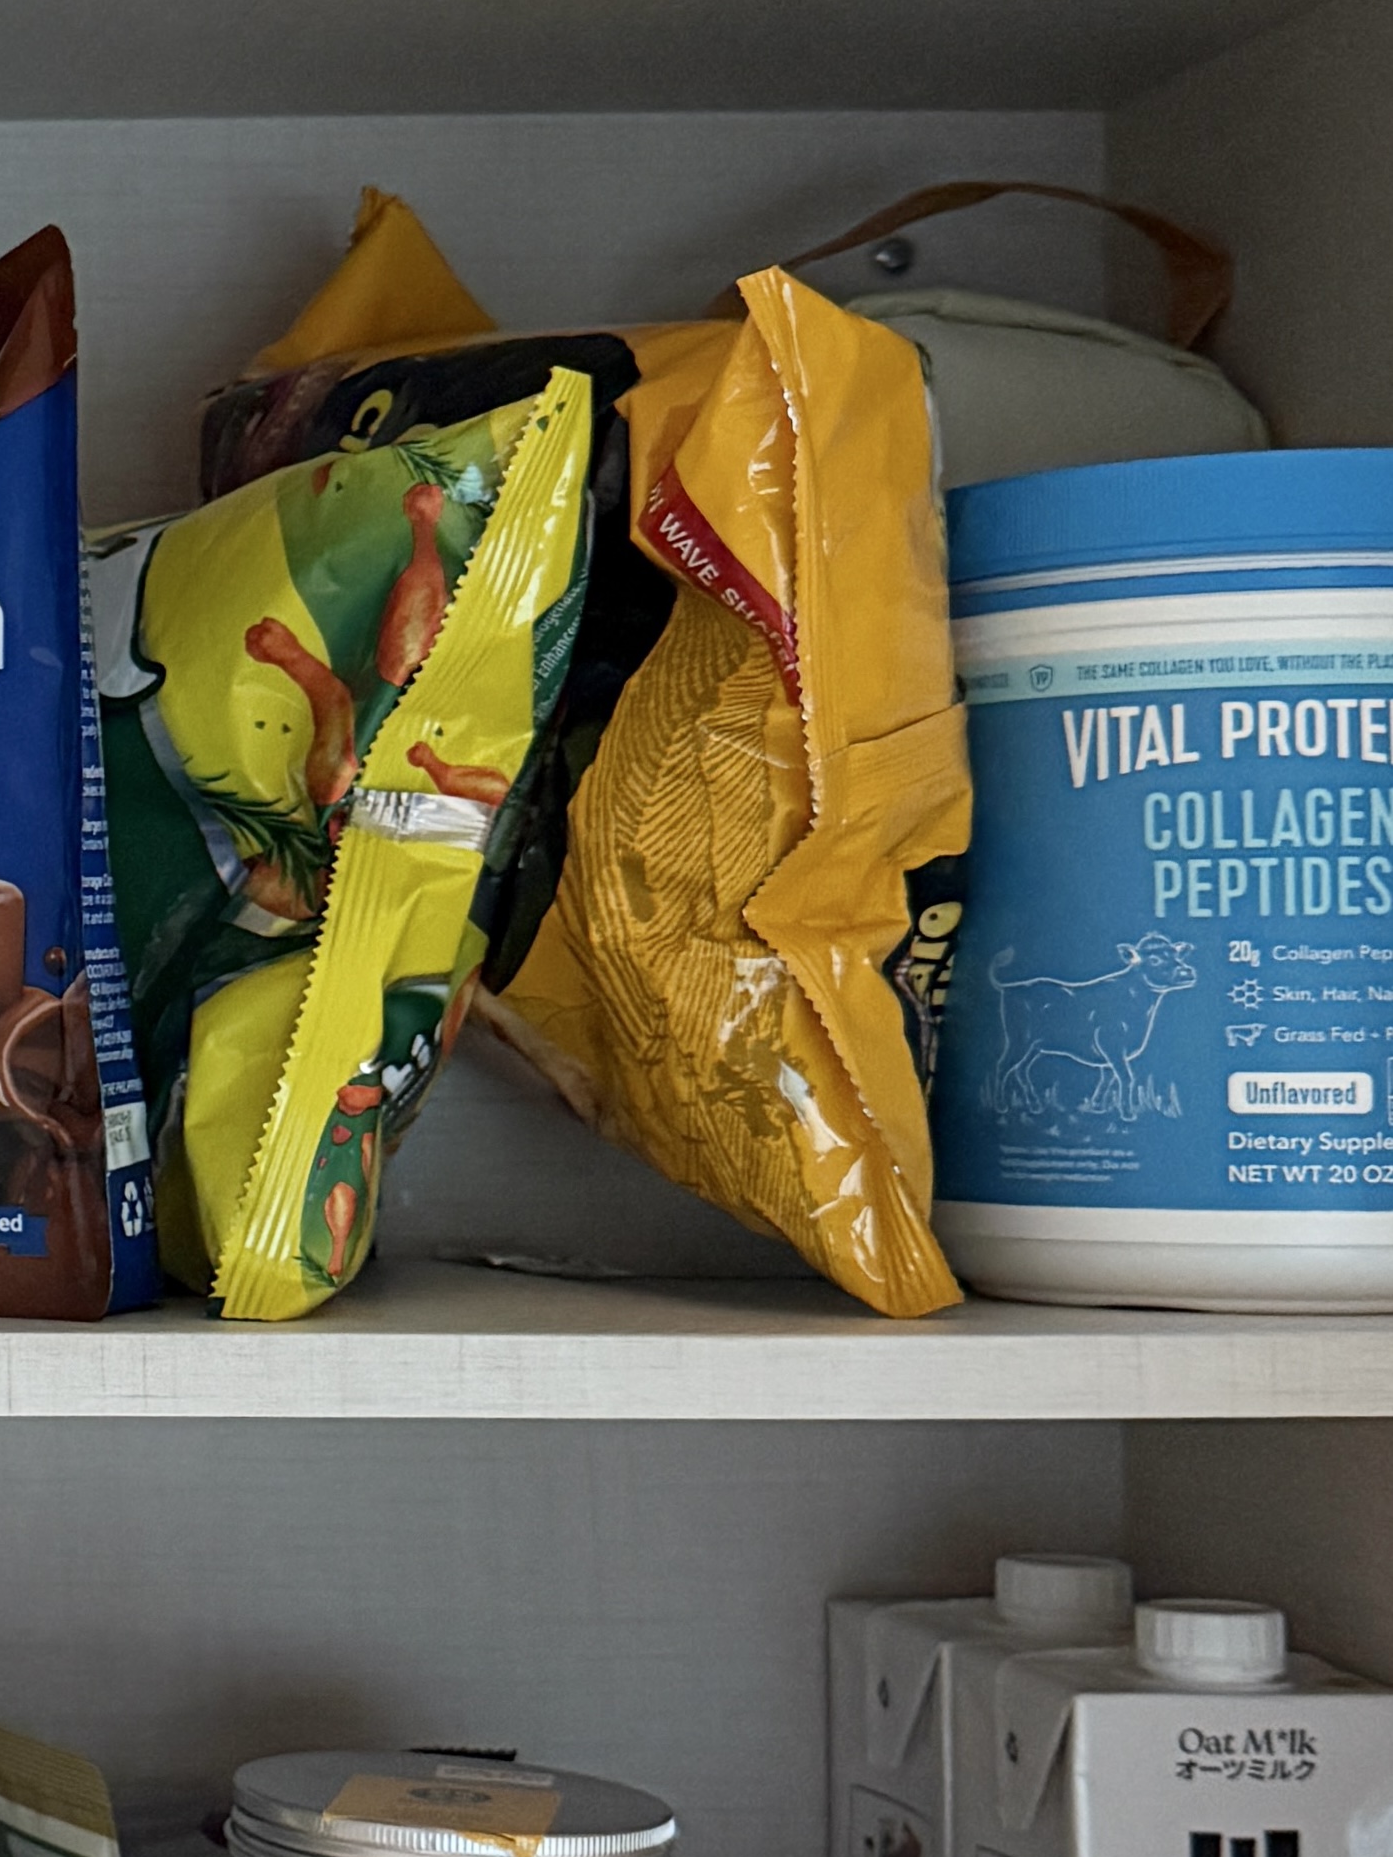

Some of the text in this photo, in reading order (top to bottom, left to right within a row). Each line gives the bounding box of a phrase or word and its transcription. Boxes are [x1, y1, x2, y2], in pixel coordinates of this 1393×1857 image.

[658, 511, 721, 588] WAVE
[1077, 664, 1100, 681] THE
[1100, 662, 1135, 680] SAME
[1138, 658, 1204, 678] COLLAGEN
[1208, 657, 1236, 674] YOU
[1277, 654, 1336, 671] WITHOUT
[1341, 653, 1364, 670] THE
[1367, 652, 1393, 670] PLA
[1062, 703, 1201, 789] VITAL
[1153, 855, 1393, 918] PEPTIDES
[1229, 939, 1393, 968] 20g Collagen Pep
[1273, 986, 1362, 1004] Skin, Hair,
[1273, 1026, 1364, 1043] Grass Fed
[1245, 1081, 1358, 1107] Unflavored
[1229, 1131, 1393, 1156] Dietary Supple
[1229, 1164, 1393, 1184] NET WT 20 OZ
[1179, 1728, 1236, 1756] Oat
[1175, 1757, 1316, 1782] オーツミルク
